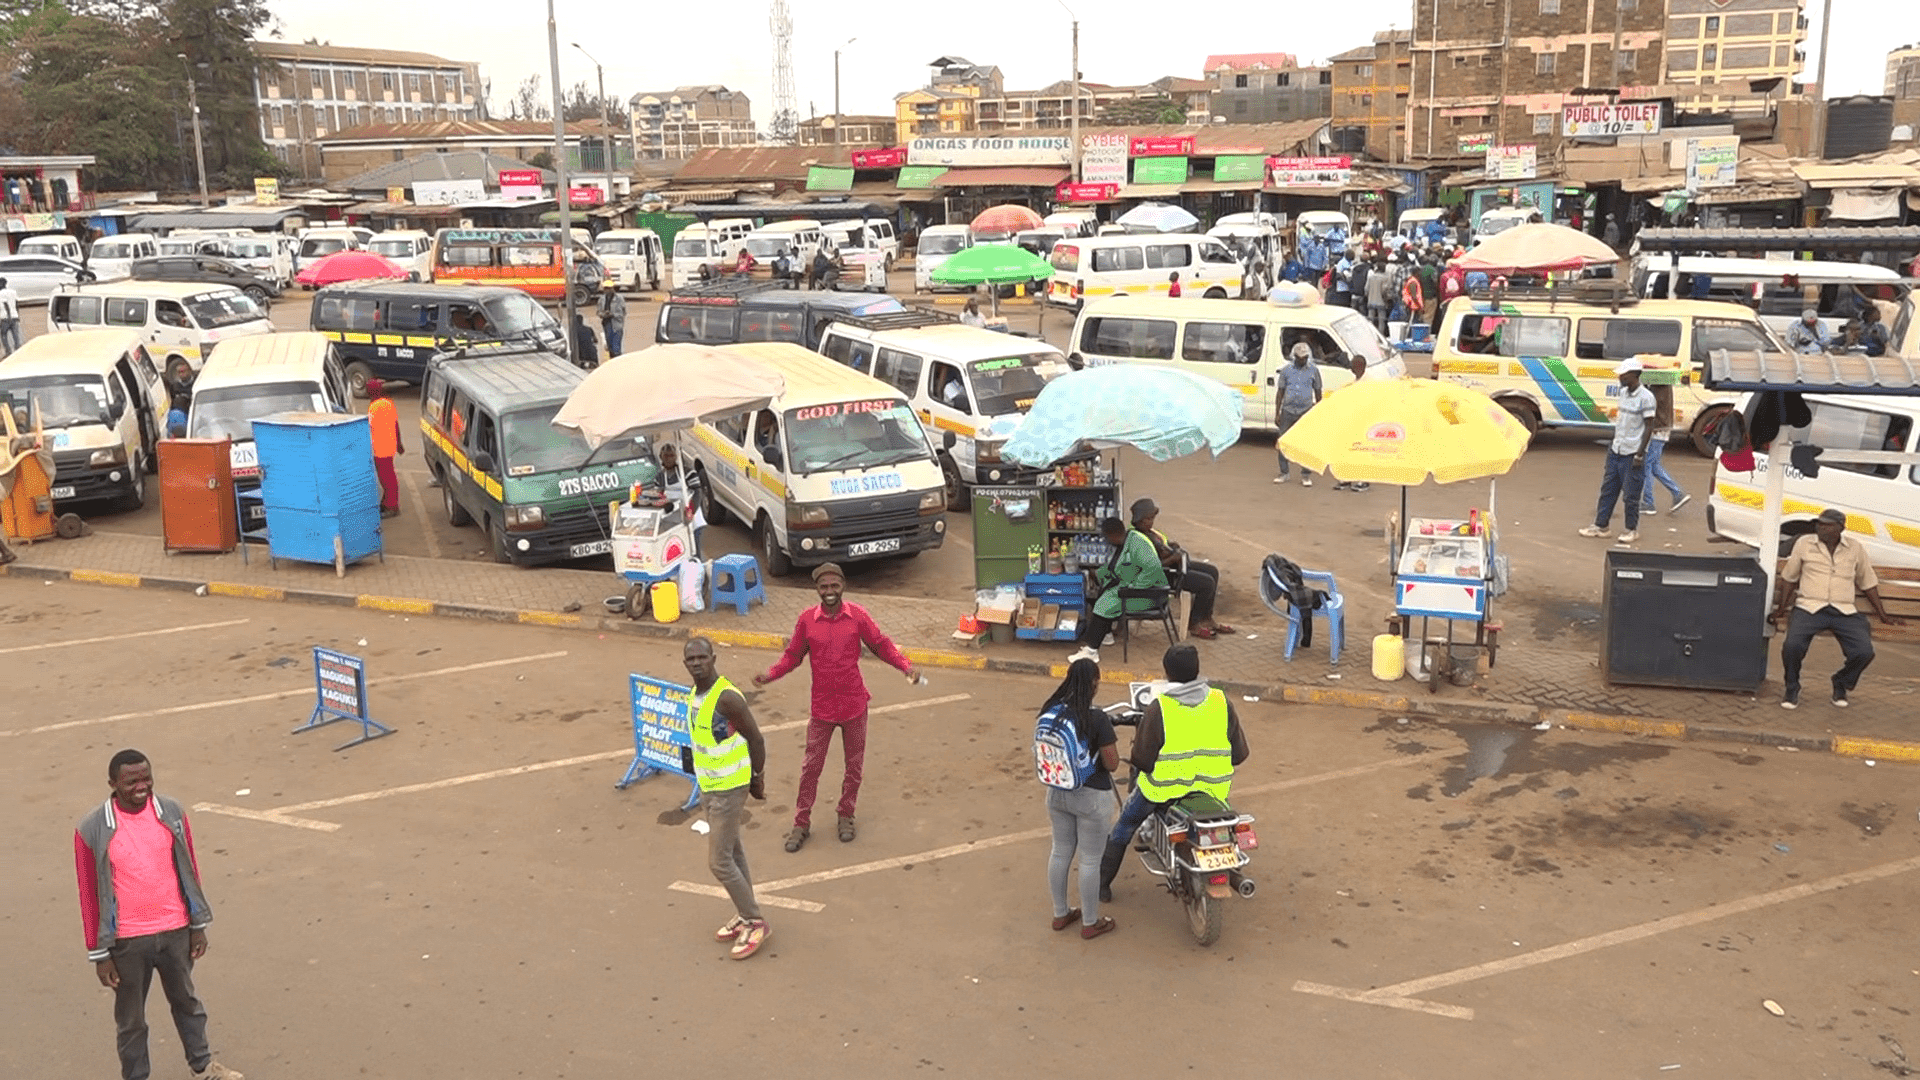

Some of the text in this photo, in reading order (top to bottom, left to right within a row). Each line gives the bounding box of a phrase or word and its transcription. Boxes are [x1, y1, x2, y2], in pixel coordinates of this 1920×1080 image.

[1565, 104, 1658, 123] PUBLIC TOILET
[1603, 121, 1634, 134] 10/=
[914, 138, 1070, 150] ONGAS FOOD HOUSE
[1082, 134, 1126, 147] CYBER
[796, 400, 894, 420] GOD FIRST
[558, 472, 619, 496] 2TS SACCO
[862, 473, 902, 491] SACCO
